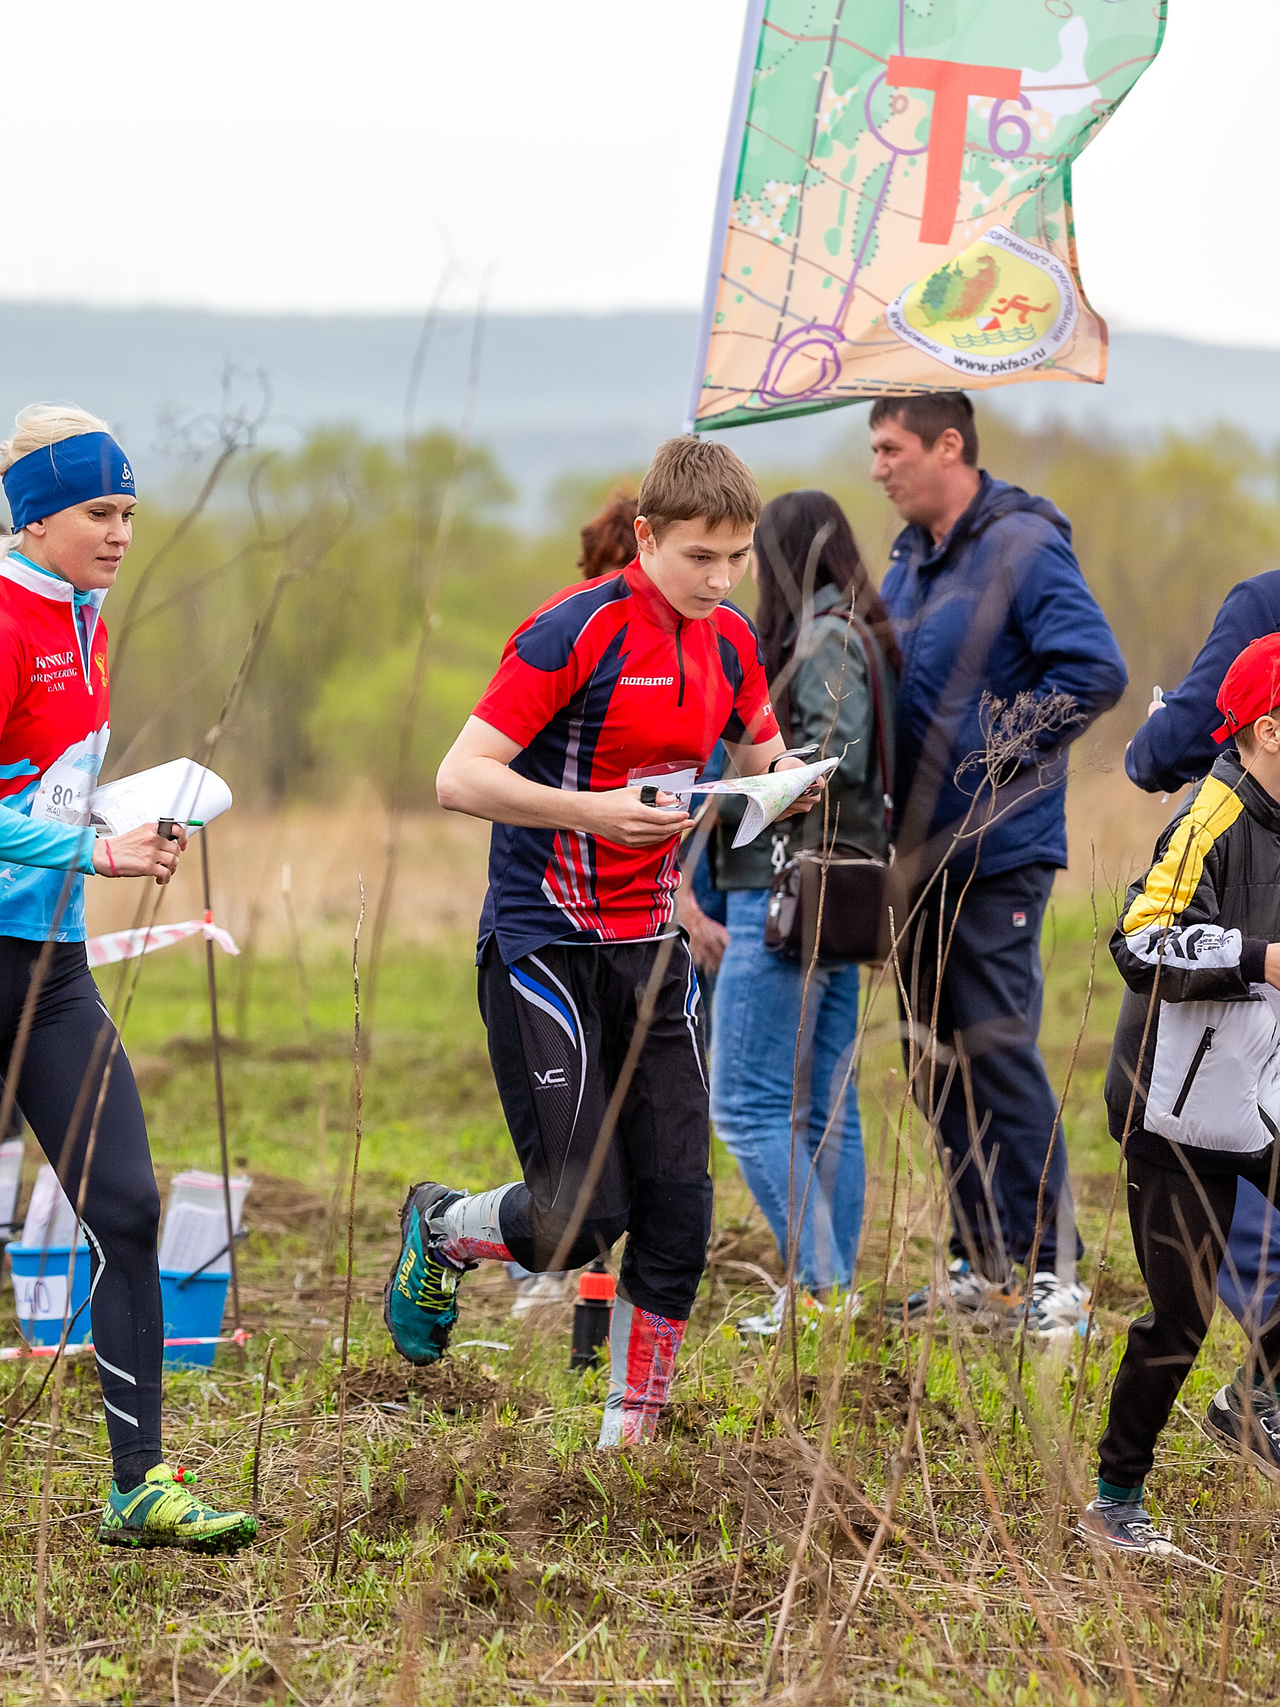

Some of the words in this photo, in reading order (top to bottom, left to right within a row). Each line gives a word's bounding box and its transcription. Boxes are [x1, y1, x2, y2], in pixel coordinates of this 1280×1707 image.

[988, 91, 1032, 159] 6
[953, 348, 1047, 374] www.pkfso.ru
[620, 676, 674, 686] noname
[533, 1068, 566, 1085] VC
